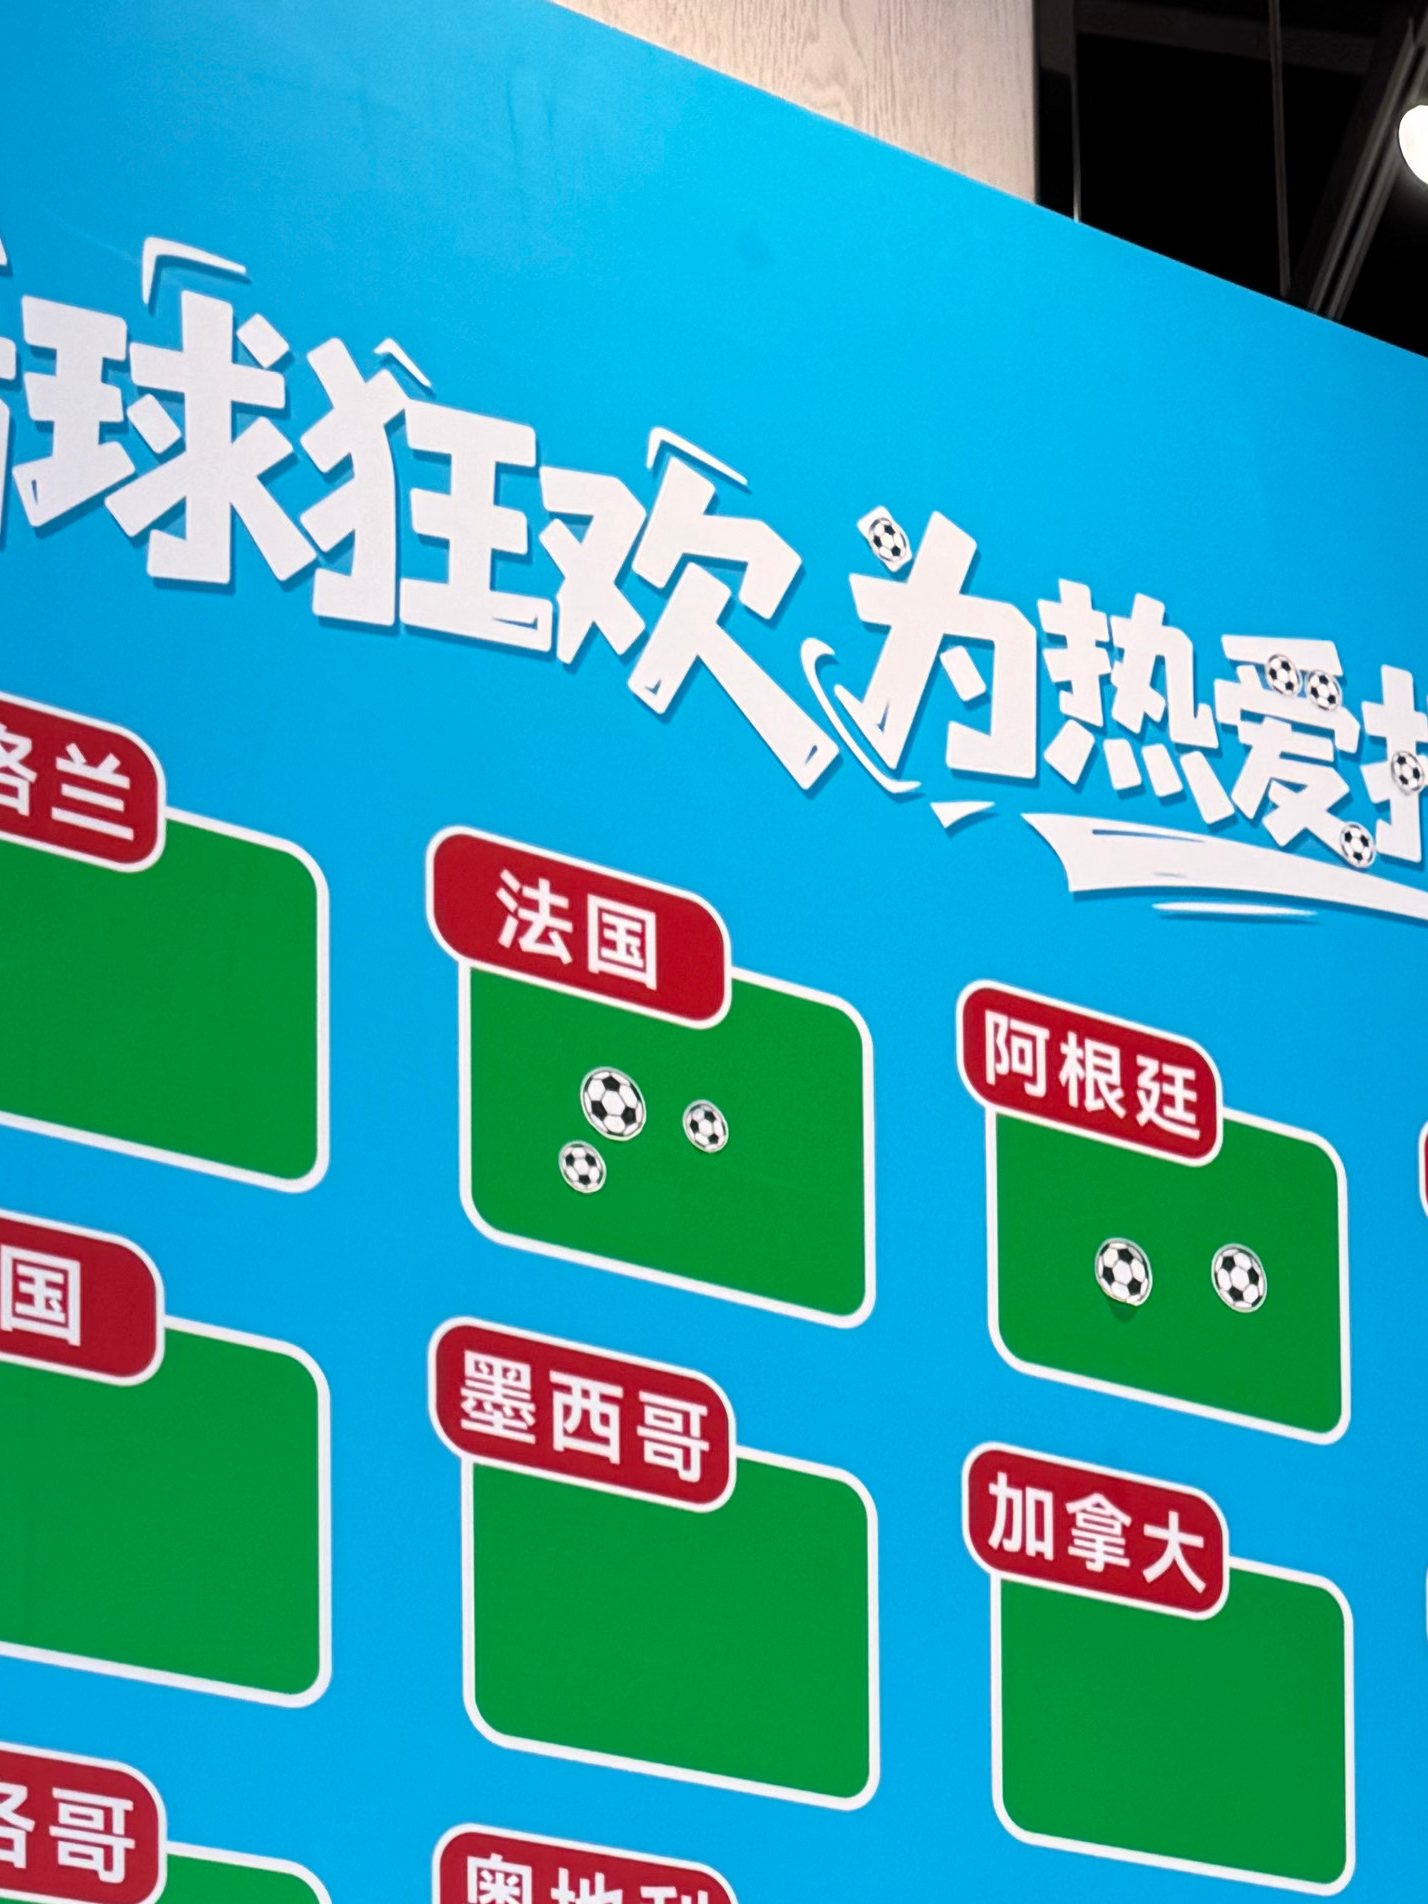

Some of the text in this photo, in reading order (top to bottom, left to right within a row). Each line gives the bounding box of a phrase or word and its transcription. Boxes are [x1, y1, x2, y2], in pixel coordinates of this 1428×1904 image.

[497, 870, 656, 990] 法国
[985, 1010, 1200, 1139] 阿根廷
[461, 1350, 709, 1482] 墨西哥
[988, 1472, 1205, 1593] 加拿大
